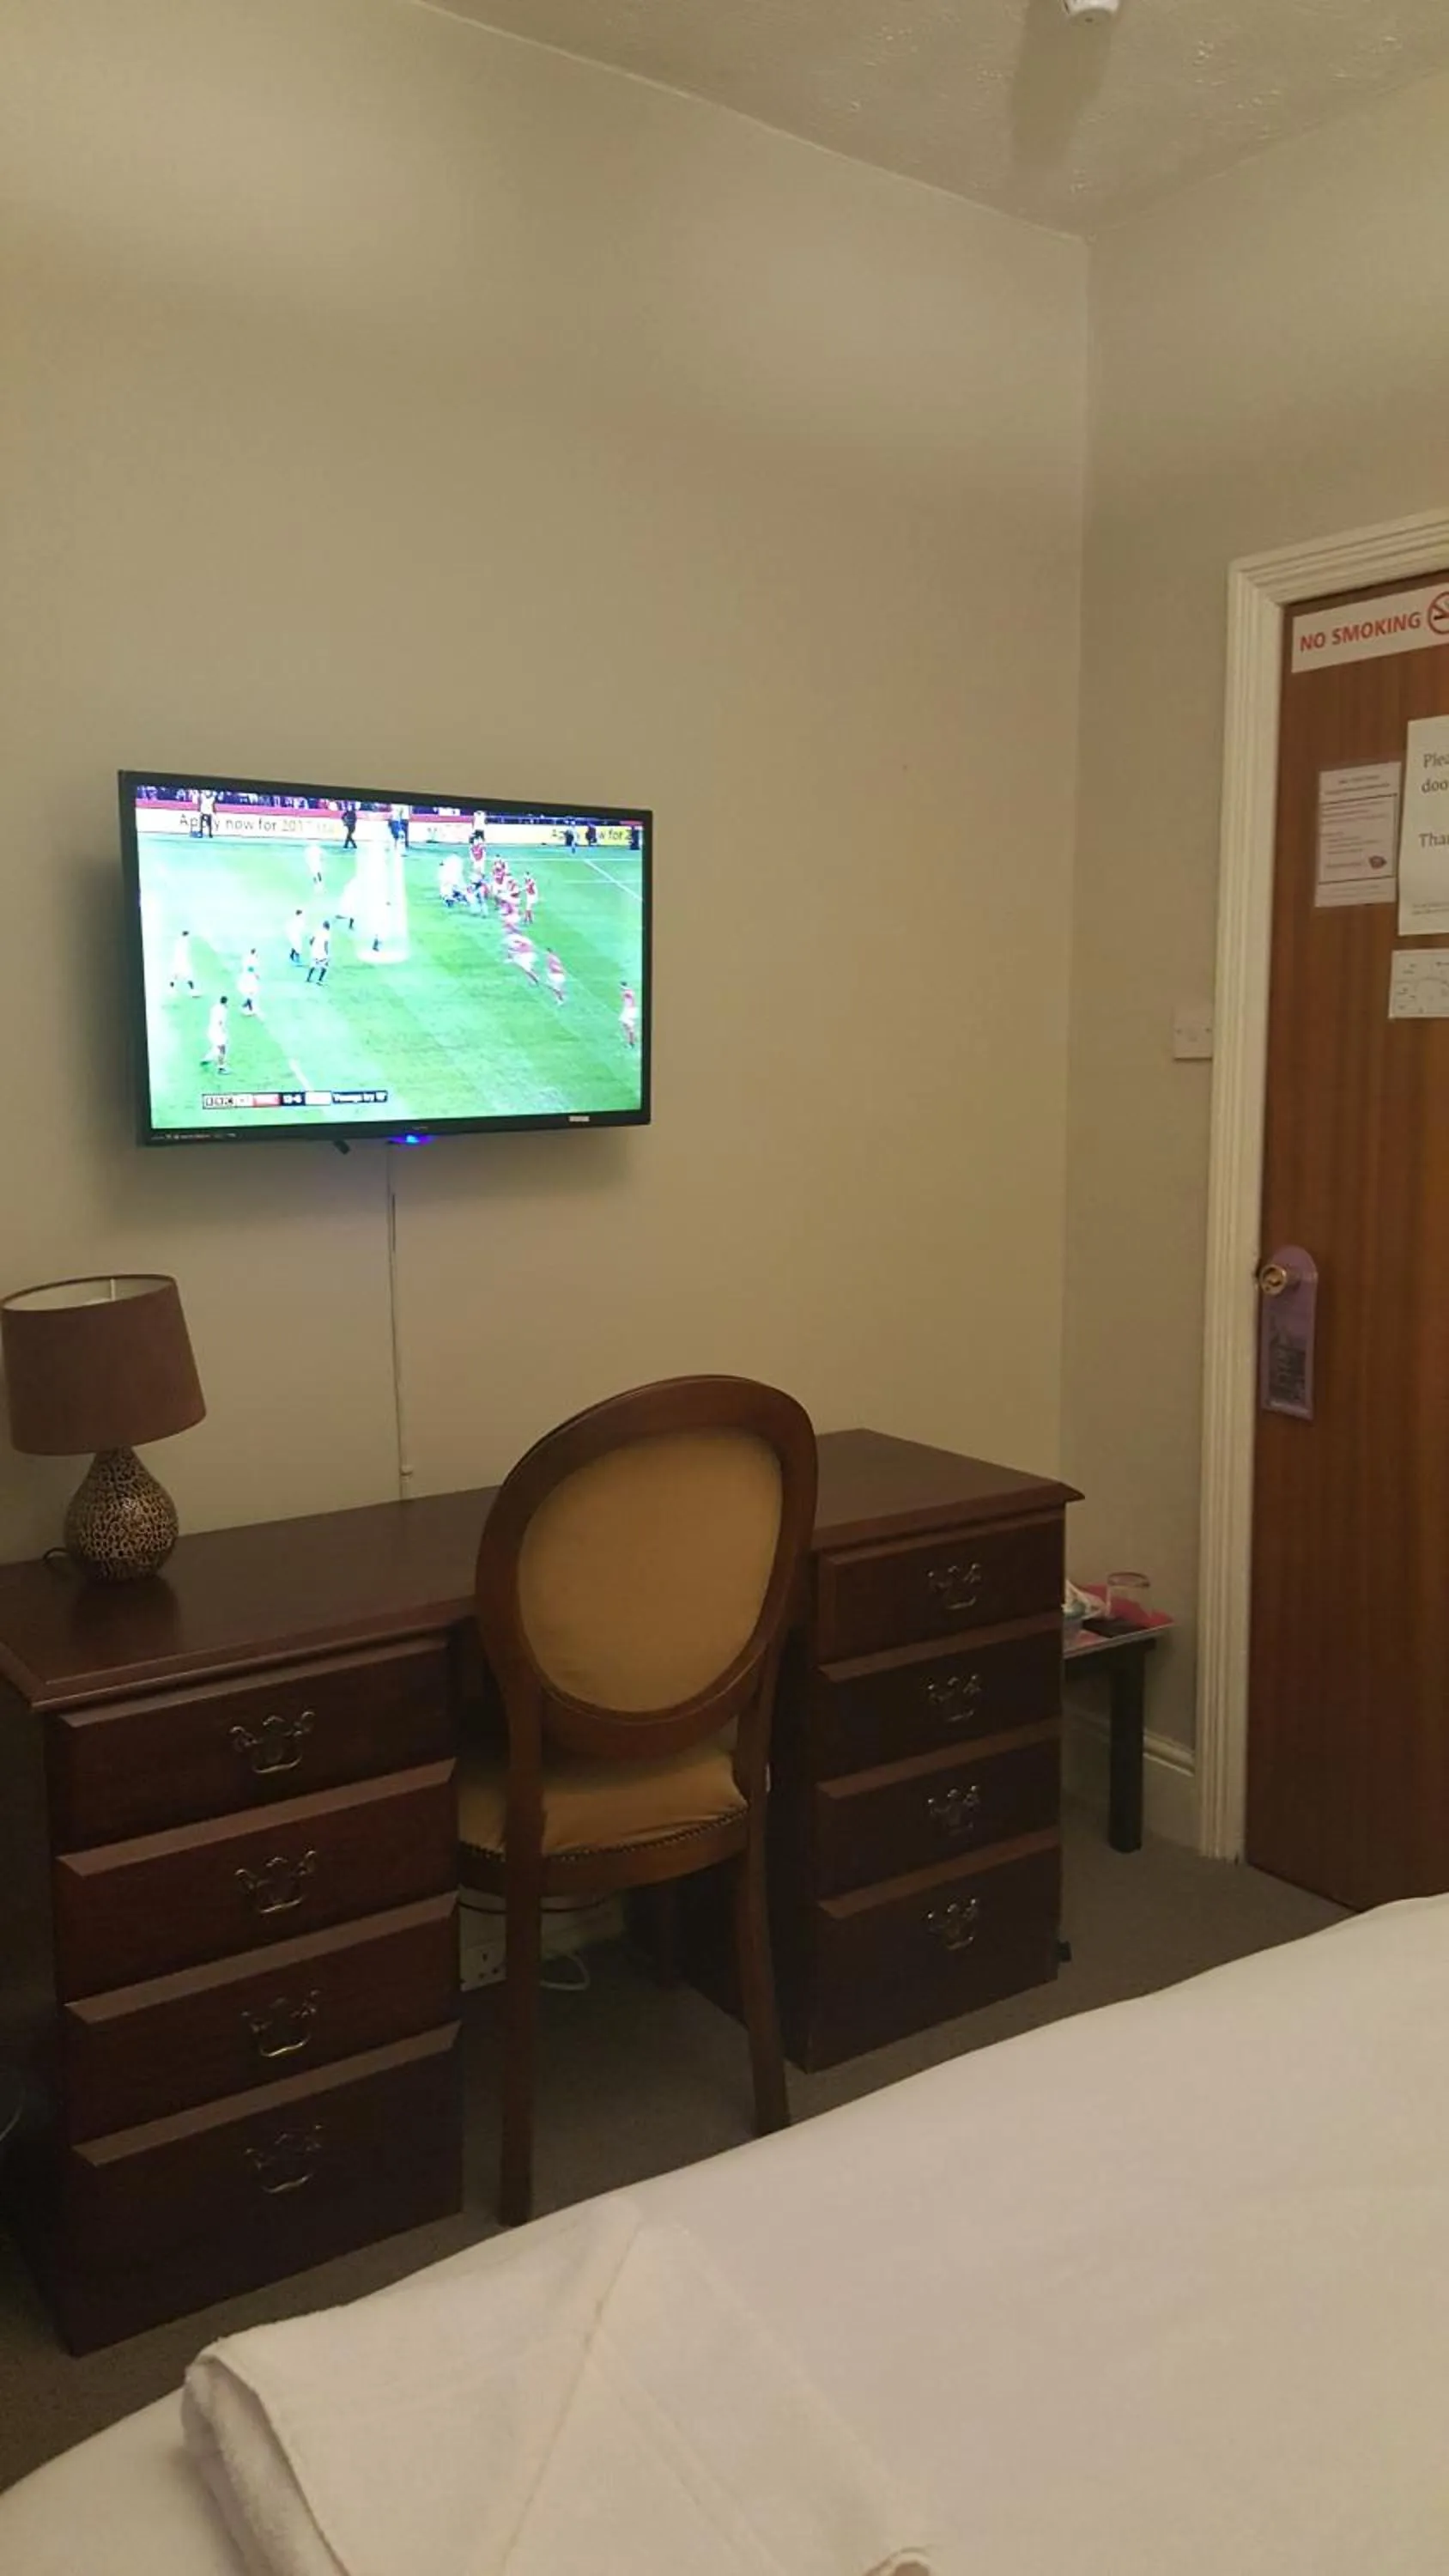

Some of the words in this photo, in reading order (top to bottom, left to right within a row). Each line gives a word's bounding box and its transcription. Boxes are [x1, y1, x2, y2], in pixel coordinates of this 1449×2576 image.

[1300, 632, 1326, 652] NO
[1331, 611, 1422, 646] SMOKING
[179, 813, 221, 833] Apy
[226, 819, 253, 831] now
[258, 818, 277, 832] for
